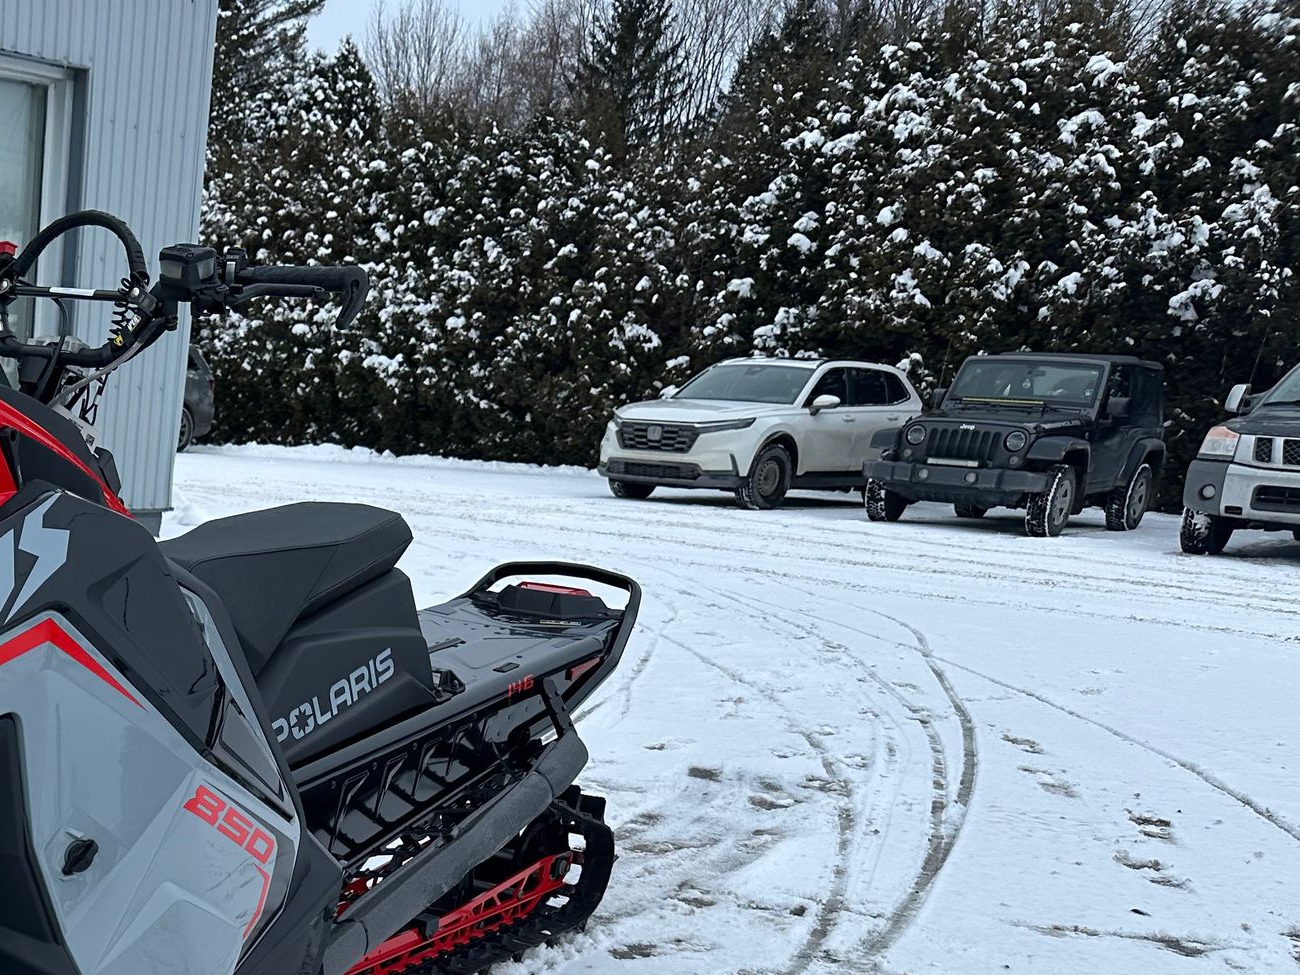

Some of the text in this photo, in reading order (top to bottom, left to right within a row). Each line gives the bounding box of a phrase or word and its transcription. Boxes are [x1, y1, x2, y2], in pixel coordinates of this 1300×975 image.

[271, 647, 395, 743] POLARIS
[507, 673, 535, 699] 146
[183, 784, 276, 865] 850
